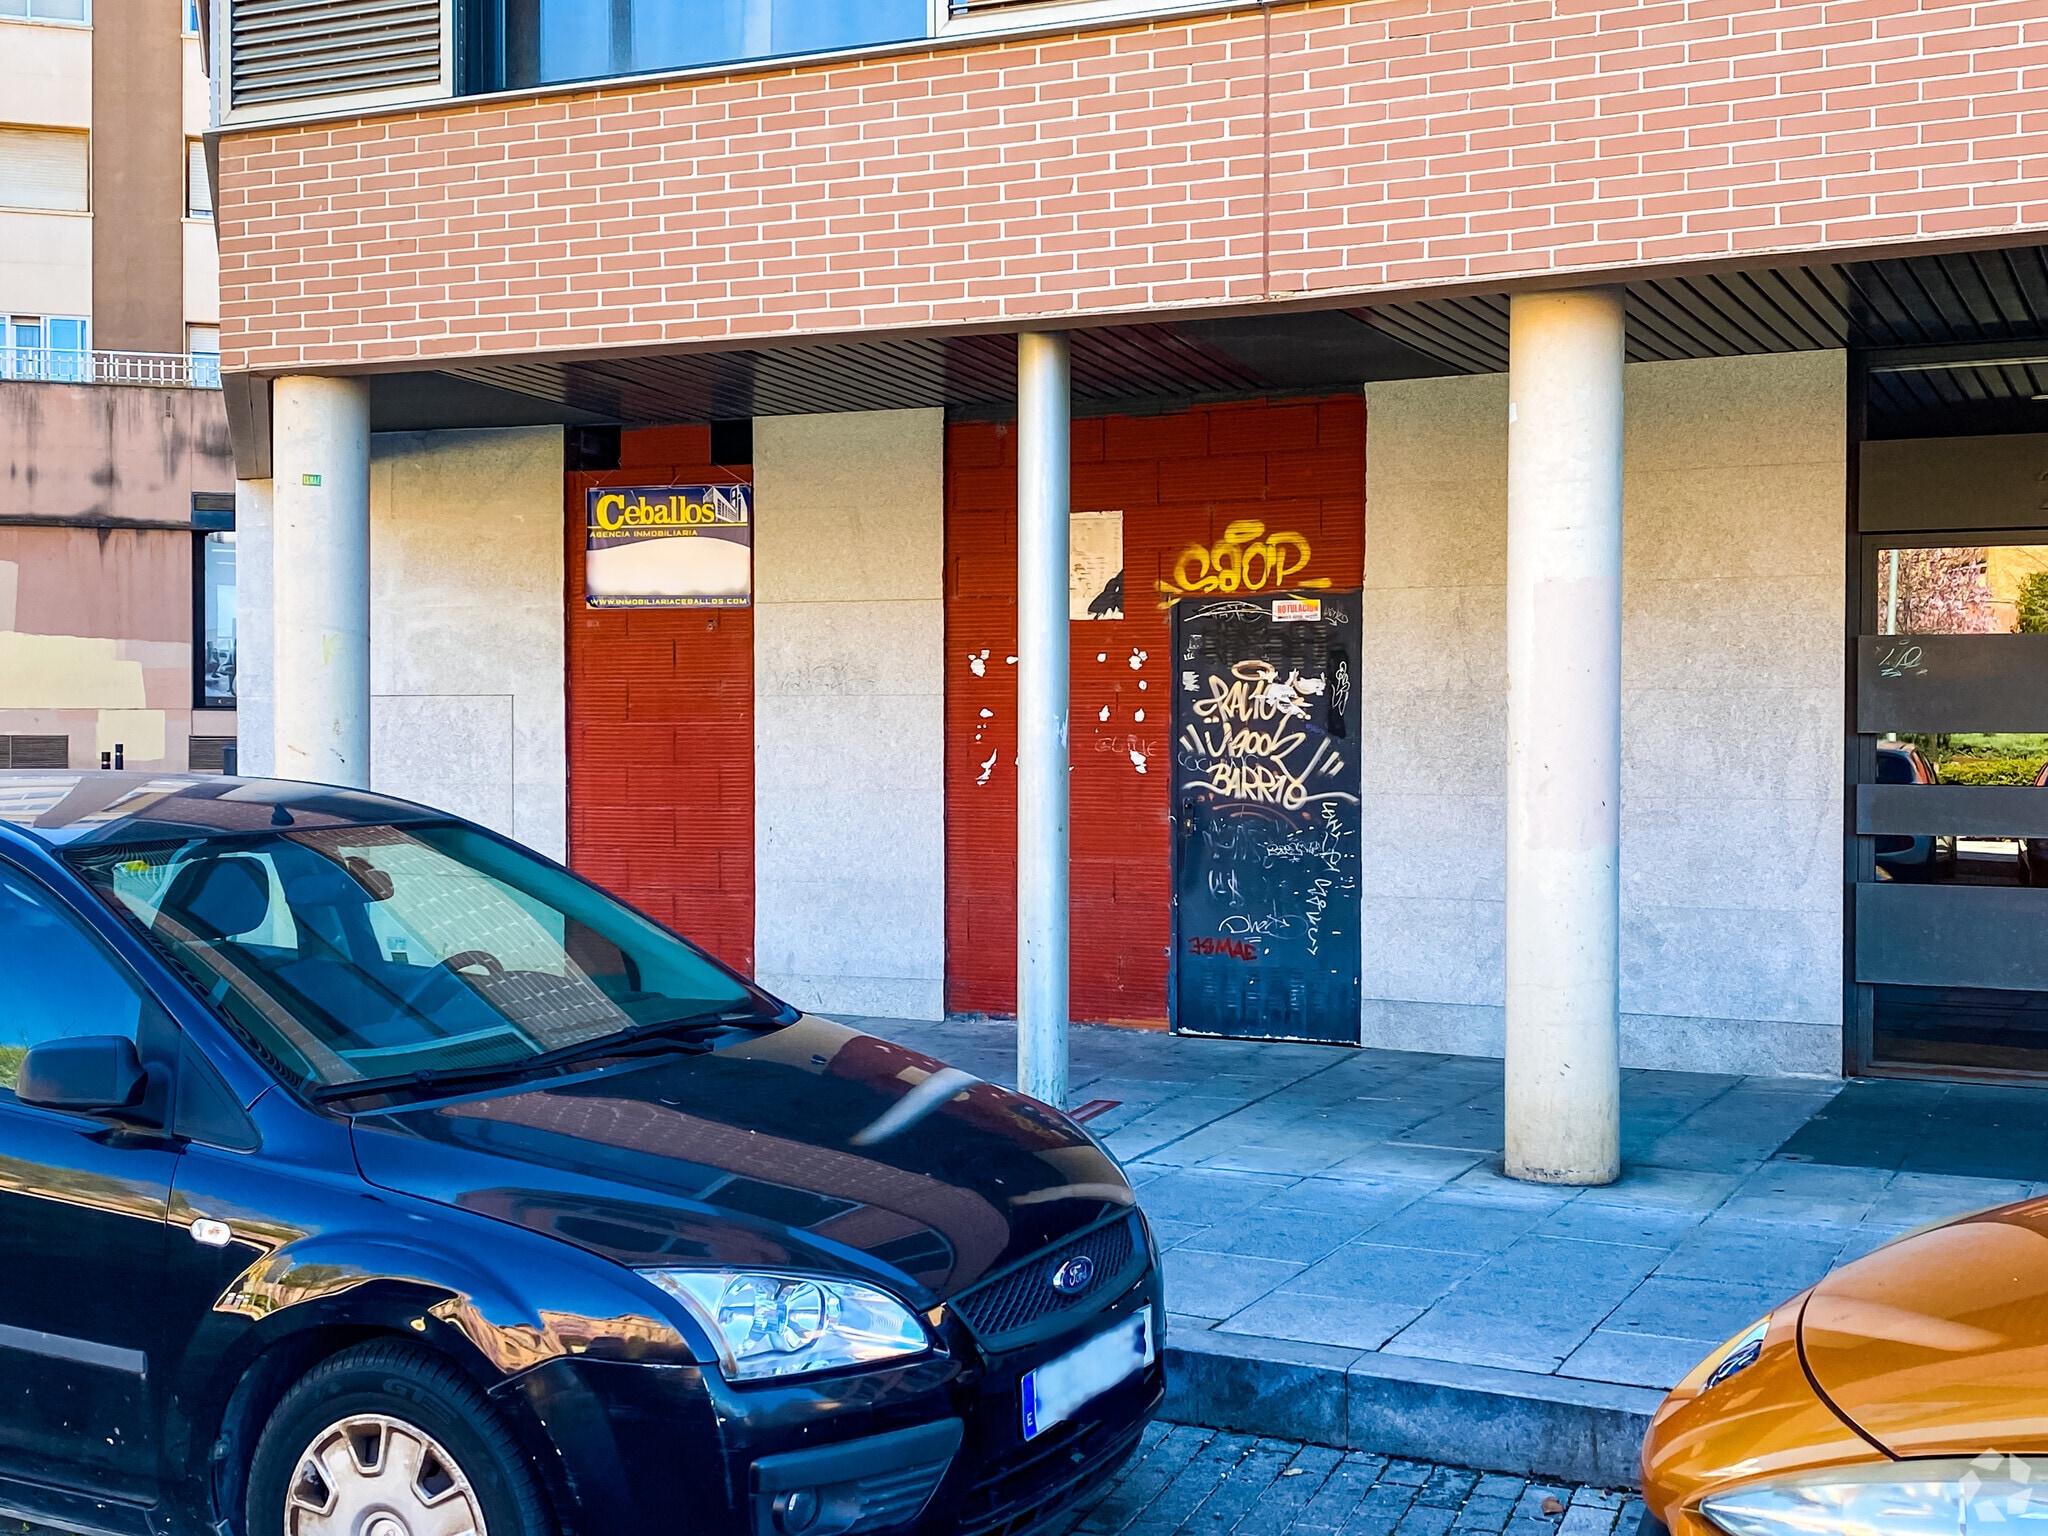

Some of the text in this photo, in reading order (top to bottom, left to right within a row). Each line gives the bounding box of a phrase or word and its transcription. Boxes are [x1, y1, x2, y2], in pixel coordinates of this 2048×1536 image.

[596, 494, 715, 531] Ceballos
[589, 529, 698, 539] AGENCIA INMOBILIARIA
[1069, 1264, 1088, 1286] Ford
[1026, 1412, 1034, 1427] E
